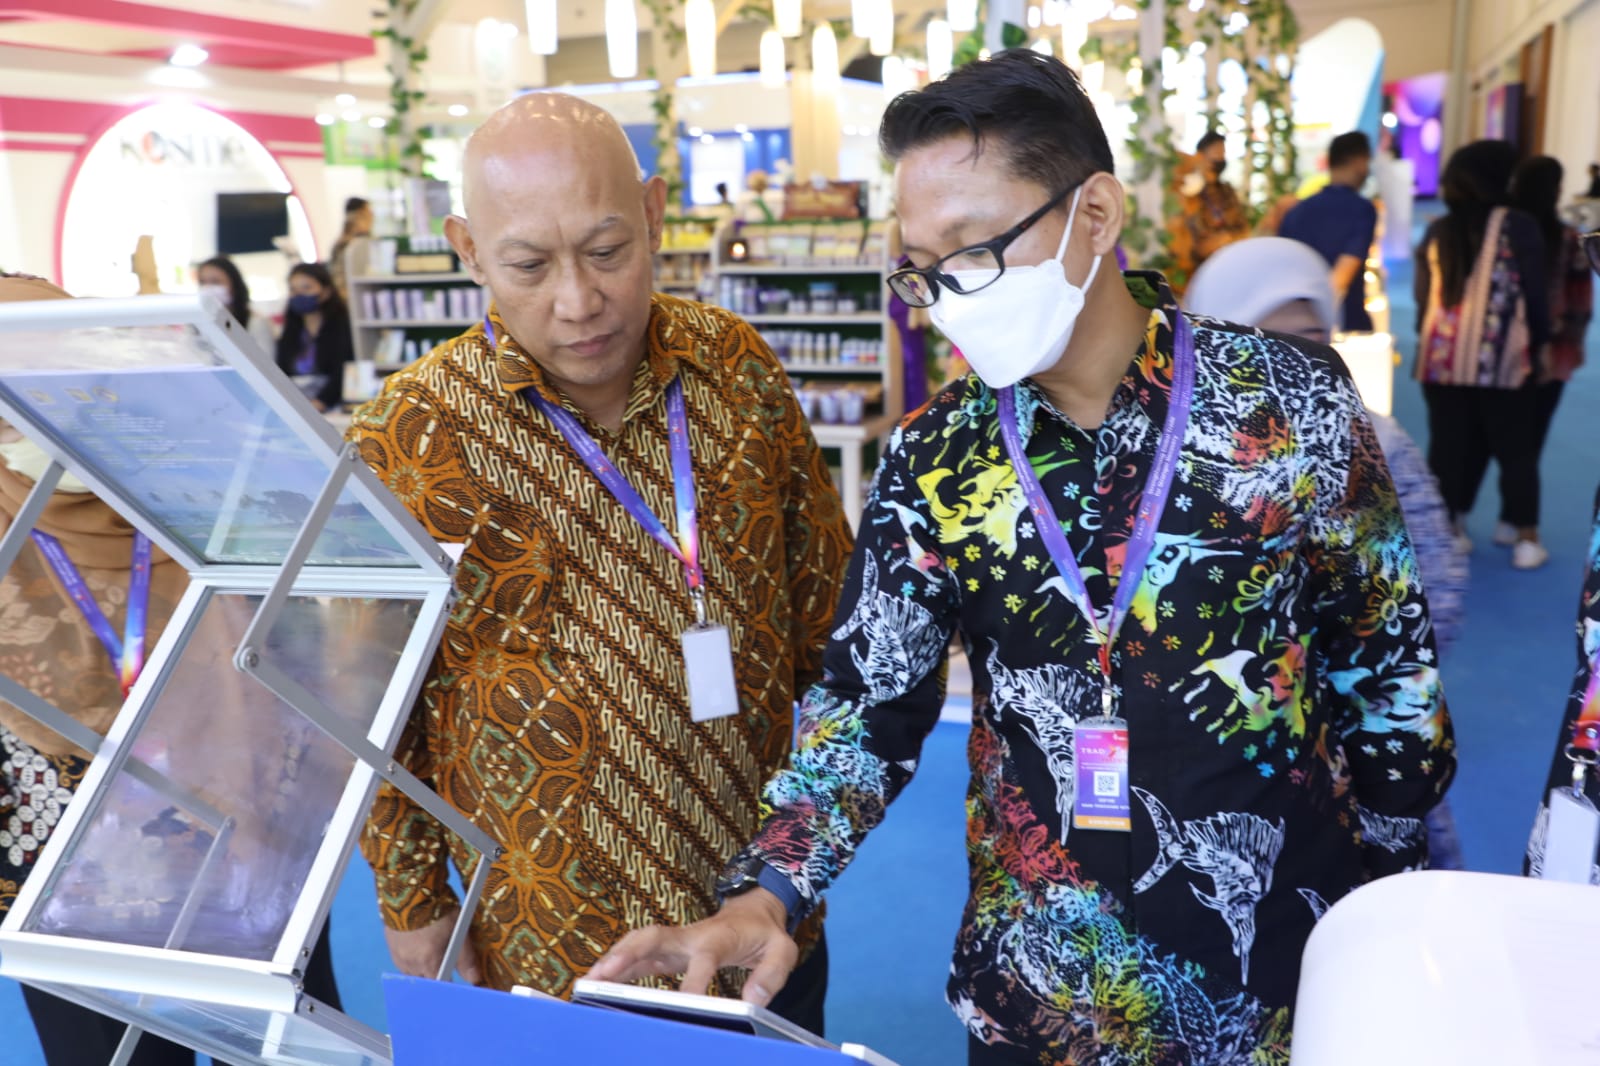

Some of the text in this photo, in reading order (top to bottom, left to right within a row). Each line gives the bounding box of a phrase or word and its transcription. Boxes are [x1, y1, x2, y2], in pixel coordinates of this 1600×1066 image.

[1159, 432, 1171, 452] Global
[1166, 415, 1176, 432] Trade
[1157, 461, 1170, 487] Stronger
[1164, 434, 1178, 462] Recovery
